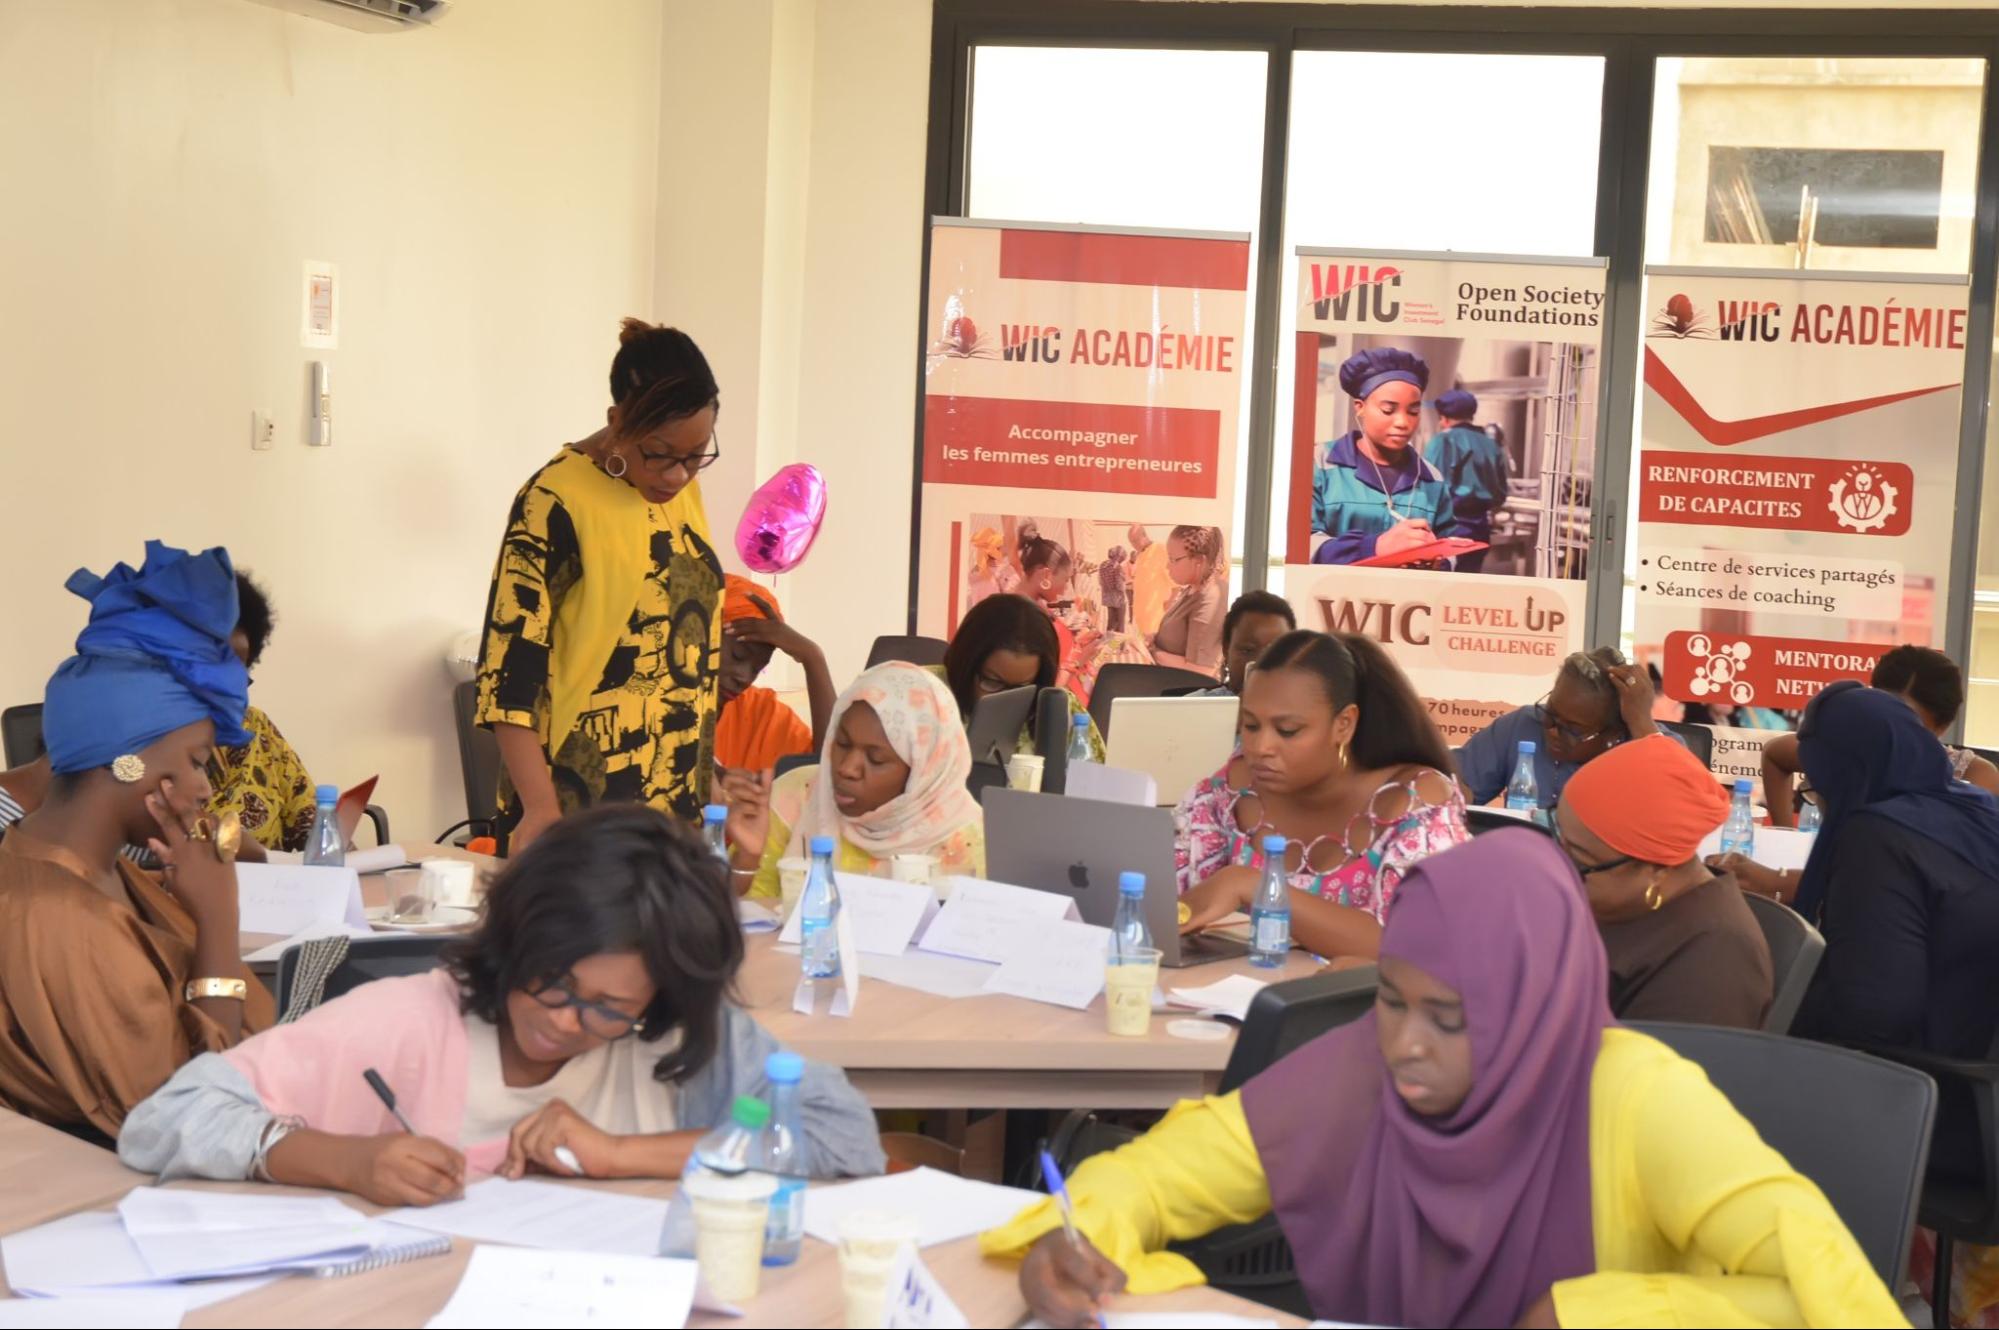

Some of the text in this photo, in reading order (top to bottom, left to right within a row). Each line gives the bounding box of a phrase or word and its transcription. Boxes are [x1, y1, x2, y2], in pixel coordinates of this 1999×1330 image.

[1310, 263, 1401, 322] WIC
[1458, 282, 1606, 310] Open Society
[1456, 304, 1599, 327] Foundations
[1718, 297, 1967, 350] WIC ACADÉMIE
[1000, 323, 1235, 373] WIC ACADÉMIE
[1007, 424, 1139, 448] Accompagner
[942, 445, 1203, 474] les femmes entrepreneures
[1648, 465, 1815, 490] RENFORCEMENT
[1659, 495, 1802, 518] DE CAPACITES
[1657, 555, 1896, 590] Centre de services partagés
[1655, 581, 1836, 613] Séances de coaching
[1317, 598, 1432, 646] WIC
[1443, 600, 1566, 632] LEVEL UP
[1447, 636, 1557, 657] CHALLENGE
[1775, 649, 1877, 672] MENTORA
